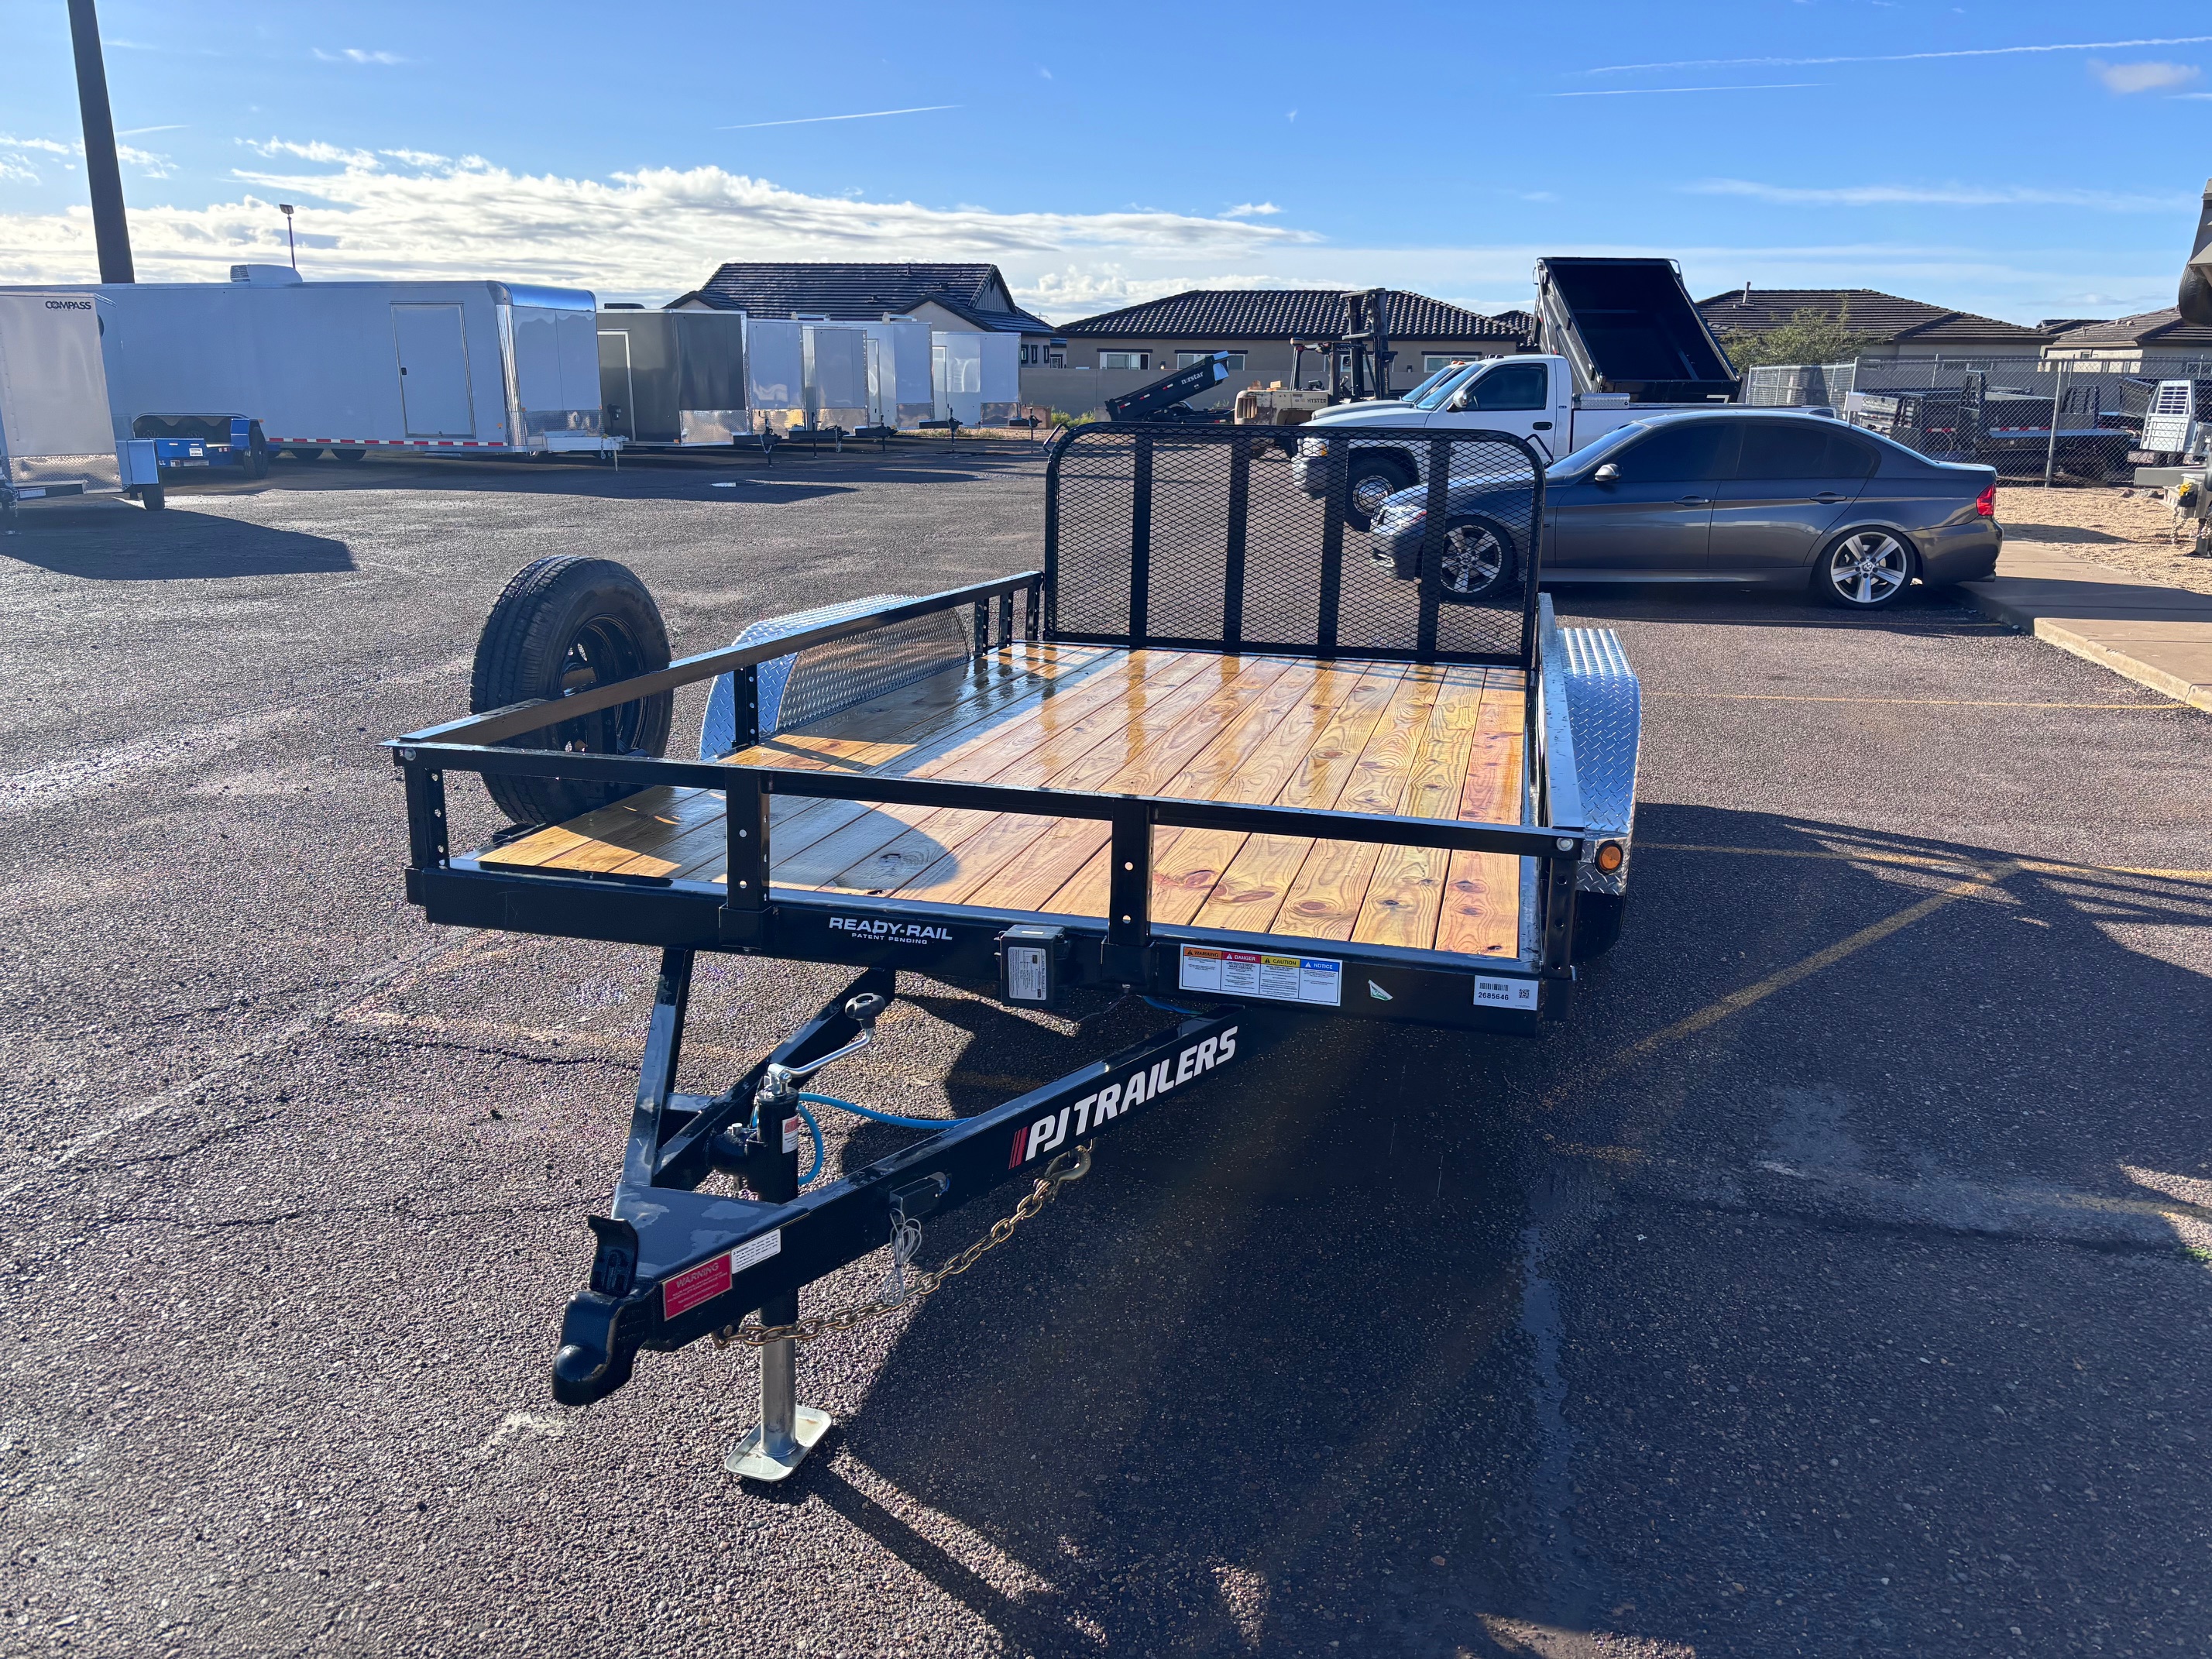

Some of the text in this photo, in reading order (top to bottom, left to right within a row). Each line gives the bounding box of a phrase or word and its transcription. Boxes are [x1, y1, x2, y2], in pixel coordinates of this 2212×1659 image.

[45, 301, 91, 310] COMPASS
[829, 917, 953, 940] READY-RAIL
[1478, 991, 1509, 1000] 2685646
[1025, 1025, 1238, 1161] PJ TRAILERS
[676, 1262, 719, 1289] WARNING
